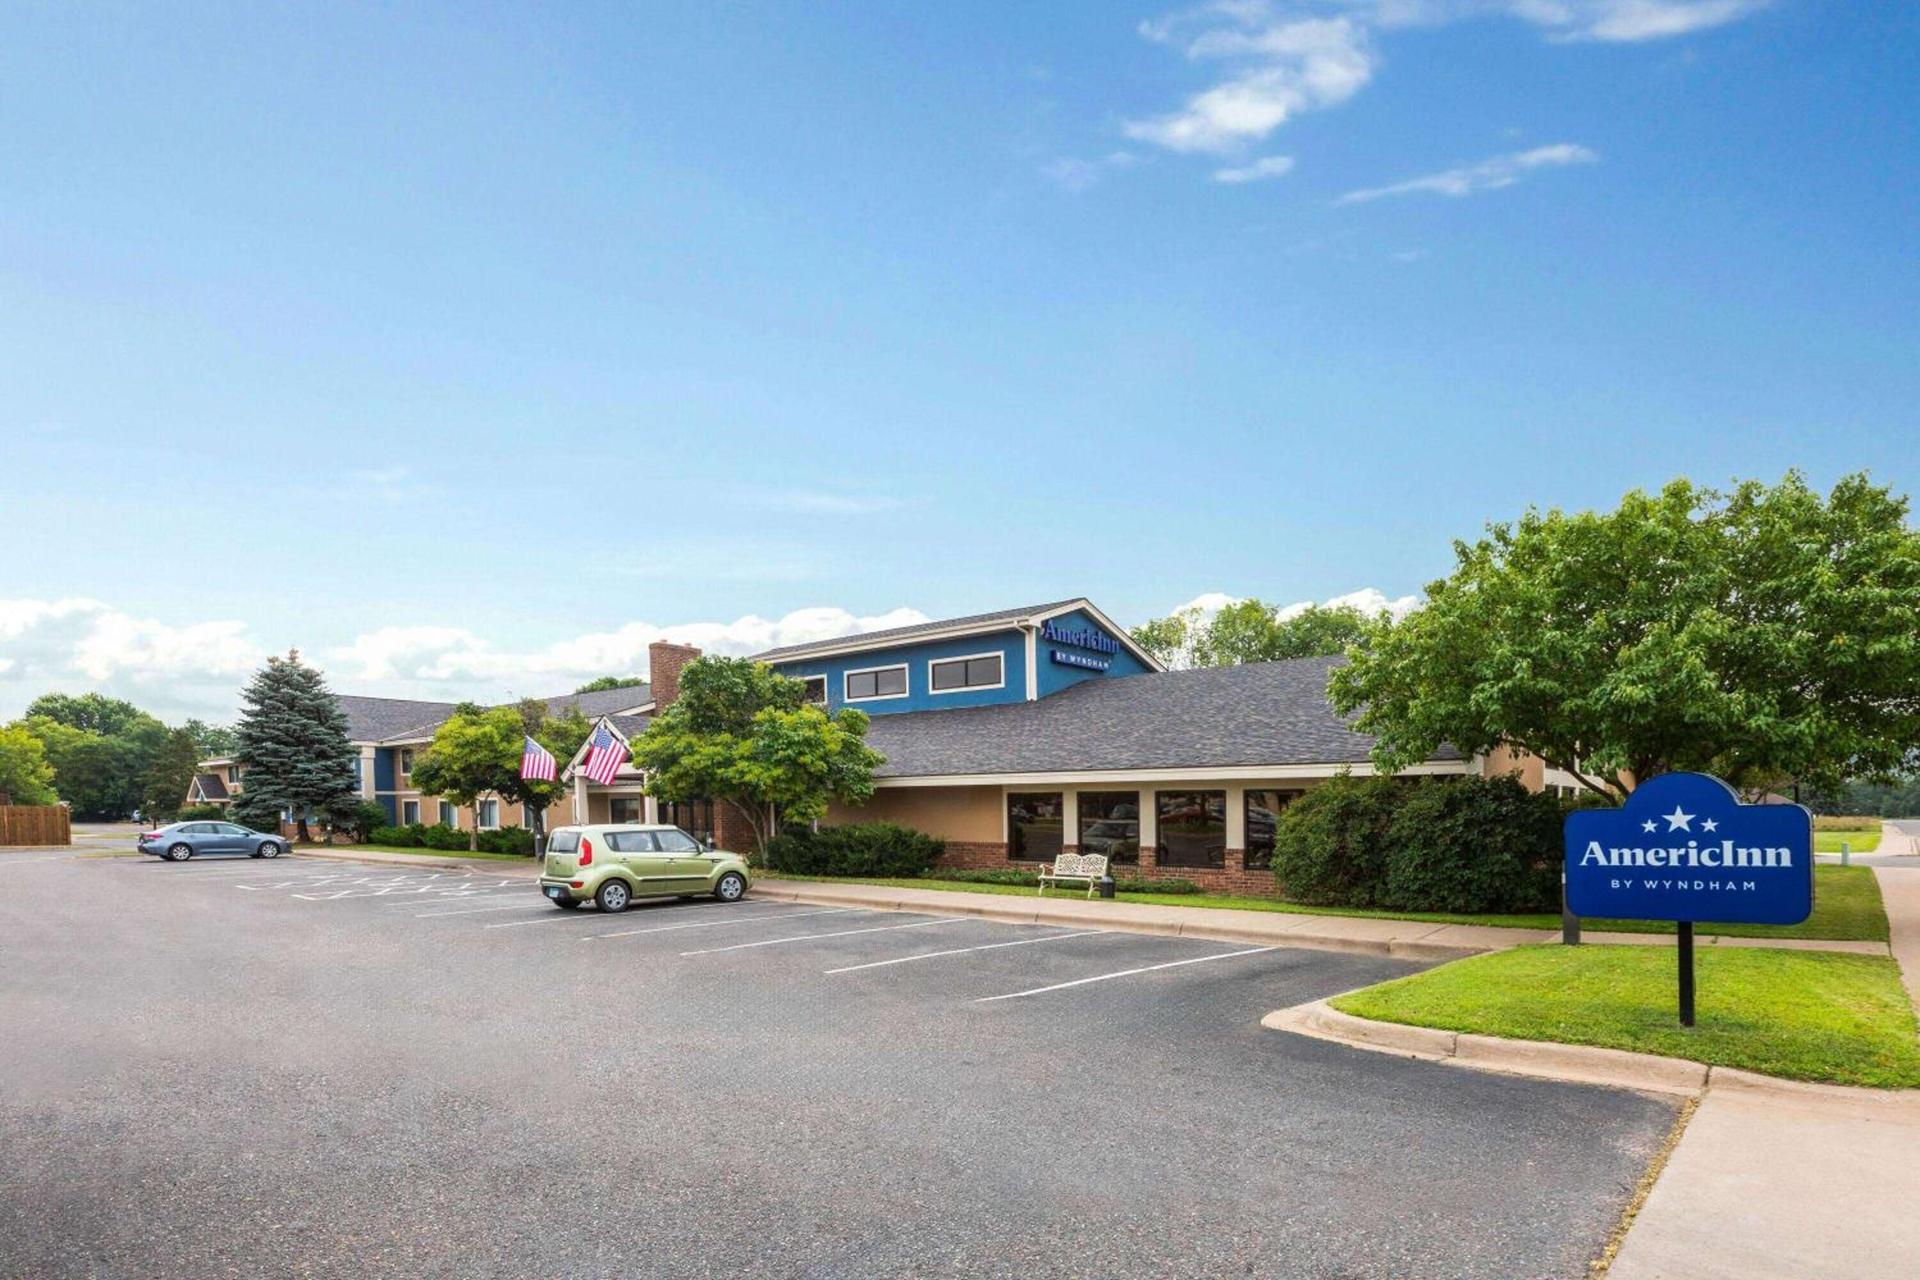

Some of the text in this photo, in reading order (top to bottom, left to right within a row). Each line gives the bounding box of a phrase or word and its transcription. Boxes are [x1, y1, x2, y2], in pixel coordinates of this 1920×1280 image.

[1044, 620, 1120, 653] AmericInn
[1056, 652, 1109, 669] BY WYNDHAM
[1579, 840, 1793, 867] AmericInn
[1611, 879, 1756, 891] BY WYNDHAM
